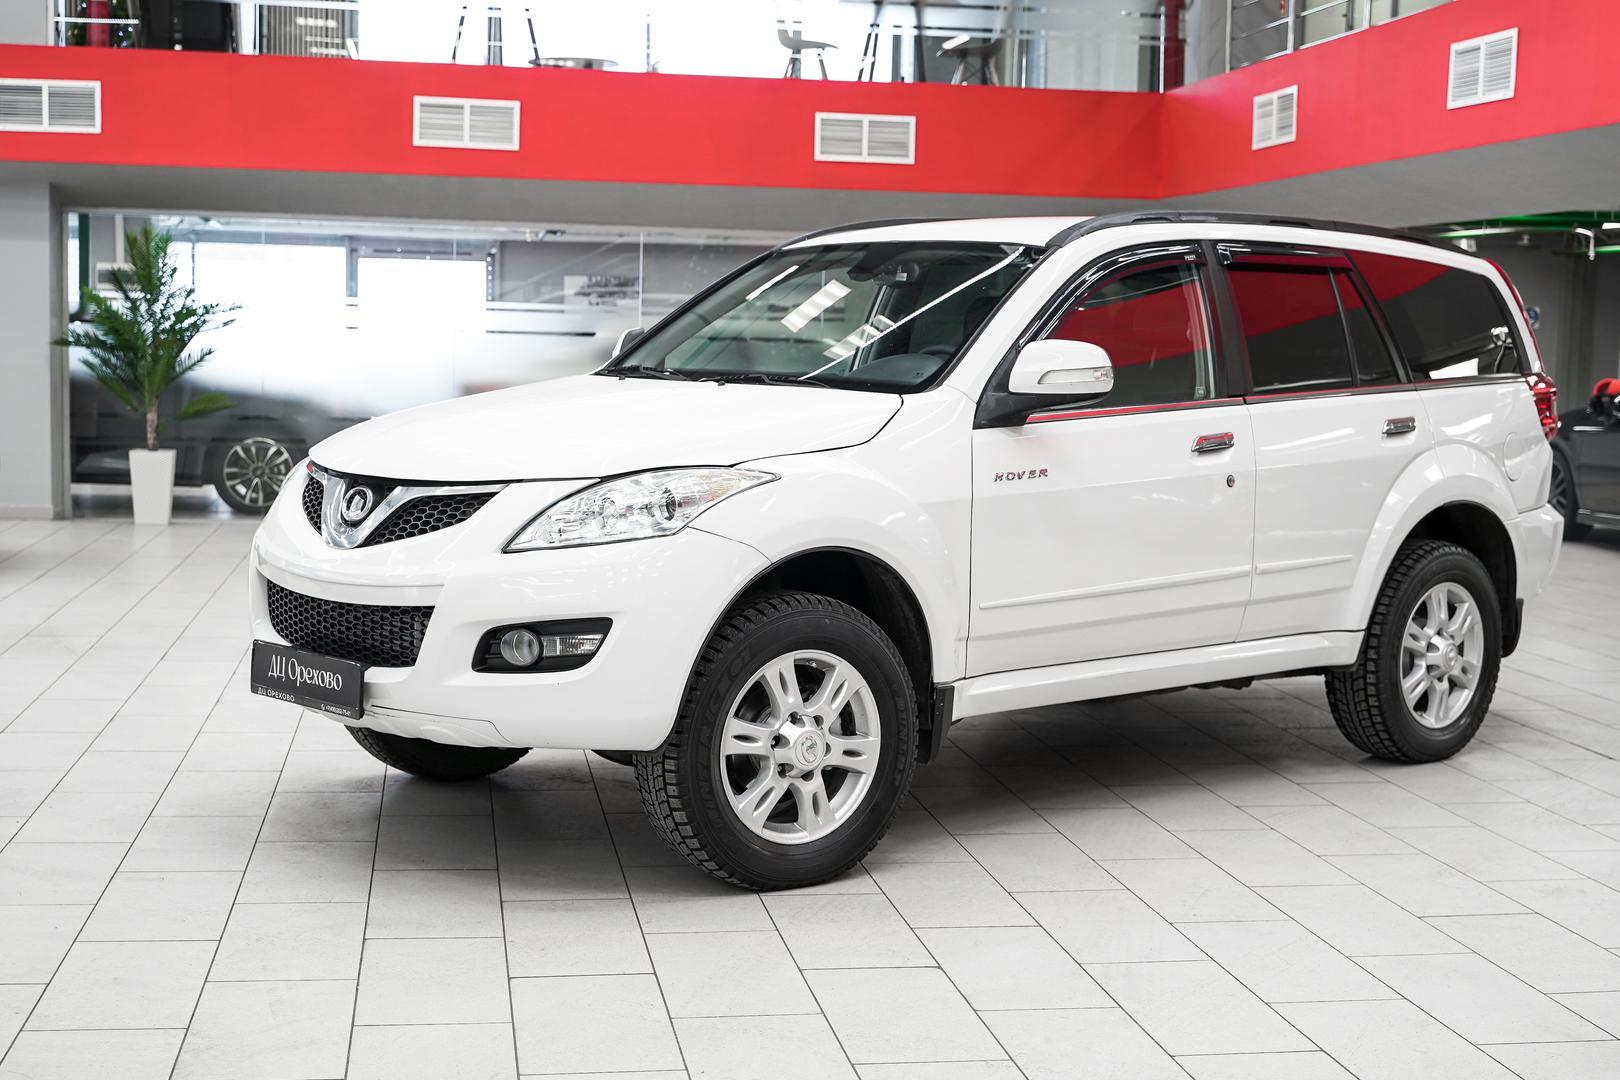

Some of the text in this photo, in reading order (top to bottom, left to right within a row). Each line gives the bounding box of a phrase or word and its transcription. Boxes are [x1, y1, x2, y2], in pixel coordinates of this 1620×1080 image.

[994, 468, 1048, 482] HOVER
[268, 654, 343, 691] ДЦ Орехово
[267, 690, 295, 702] ОРЕХОВО
